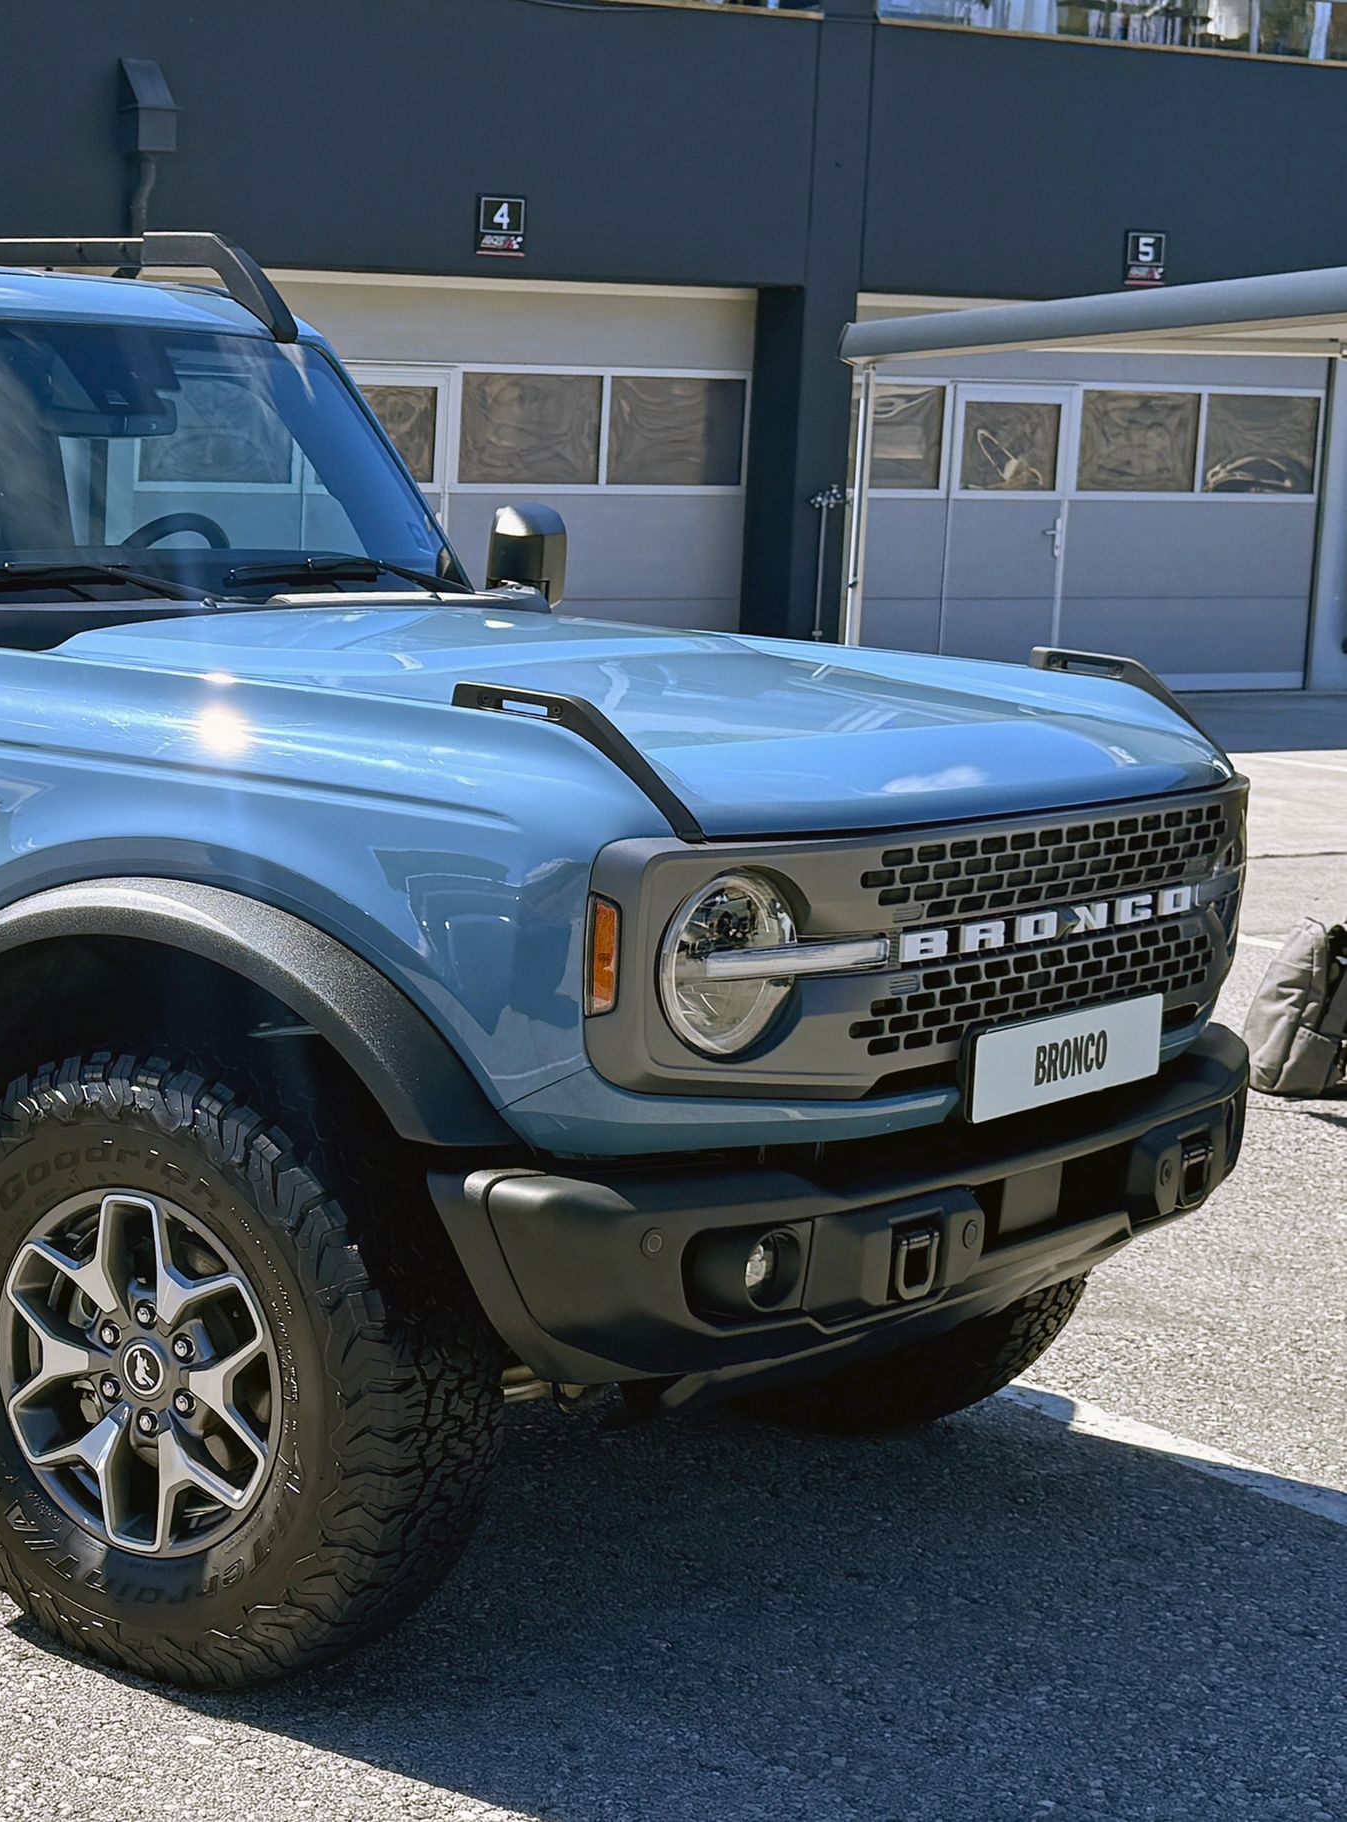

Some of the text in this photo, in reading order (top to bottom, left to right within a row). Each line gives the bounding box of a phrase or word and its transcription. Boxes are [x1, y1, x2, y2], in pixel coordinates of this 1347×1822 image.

[493, 202, 510, 230] 4
[1138, 236, 1156, 262] 5
[898, 884, 1193, 963] BRONCO
[1034, 1029, 1108, 1087] BRONCO
